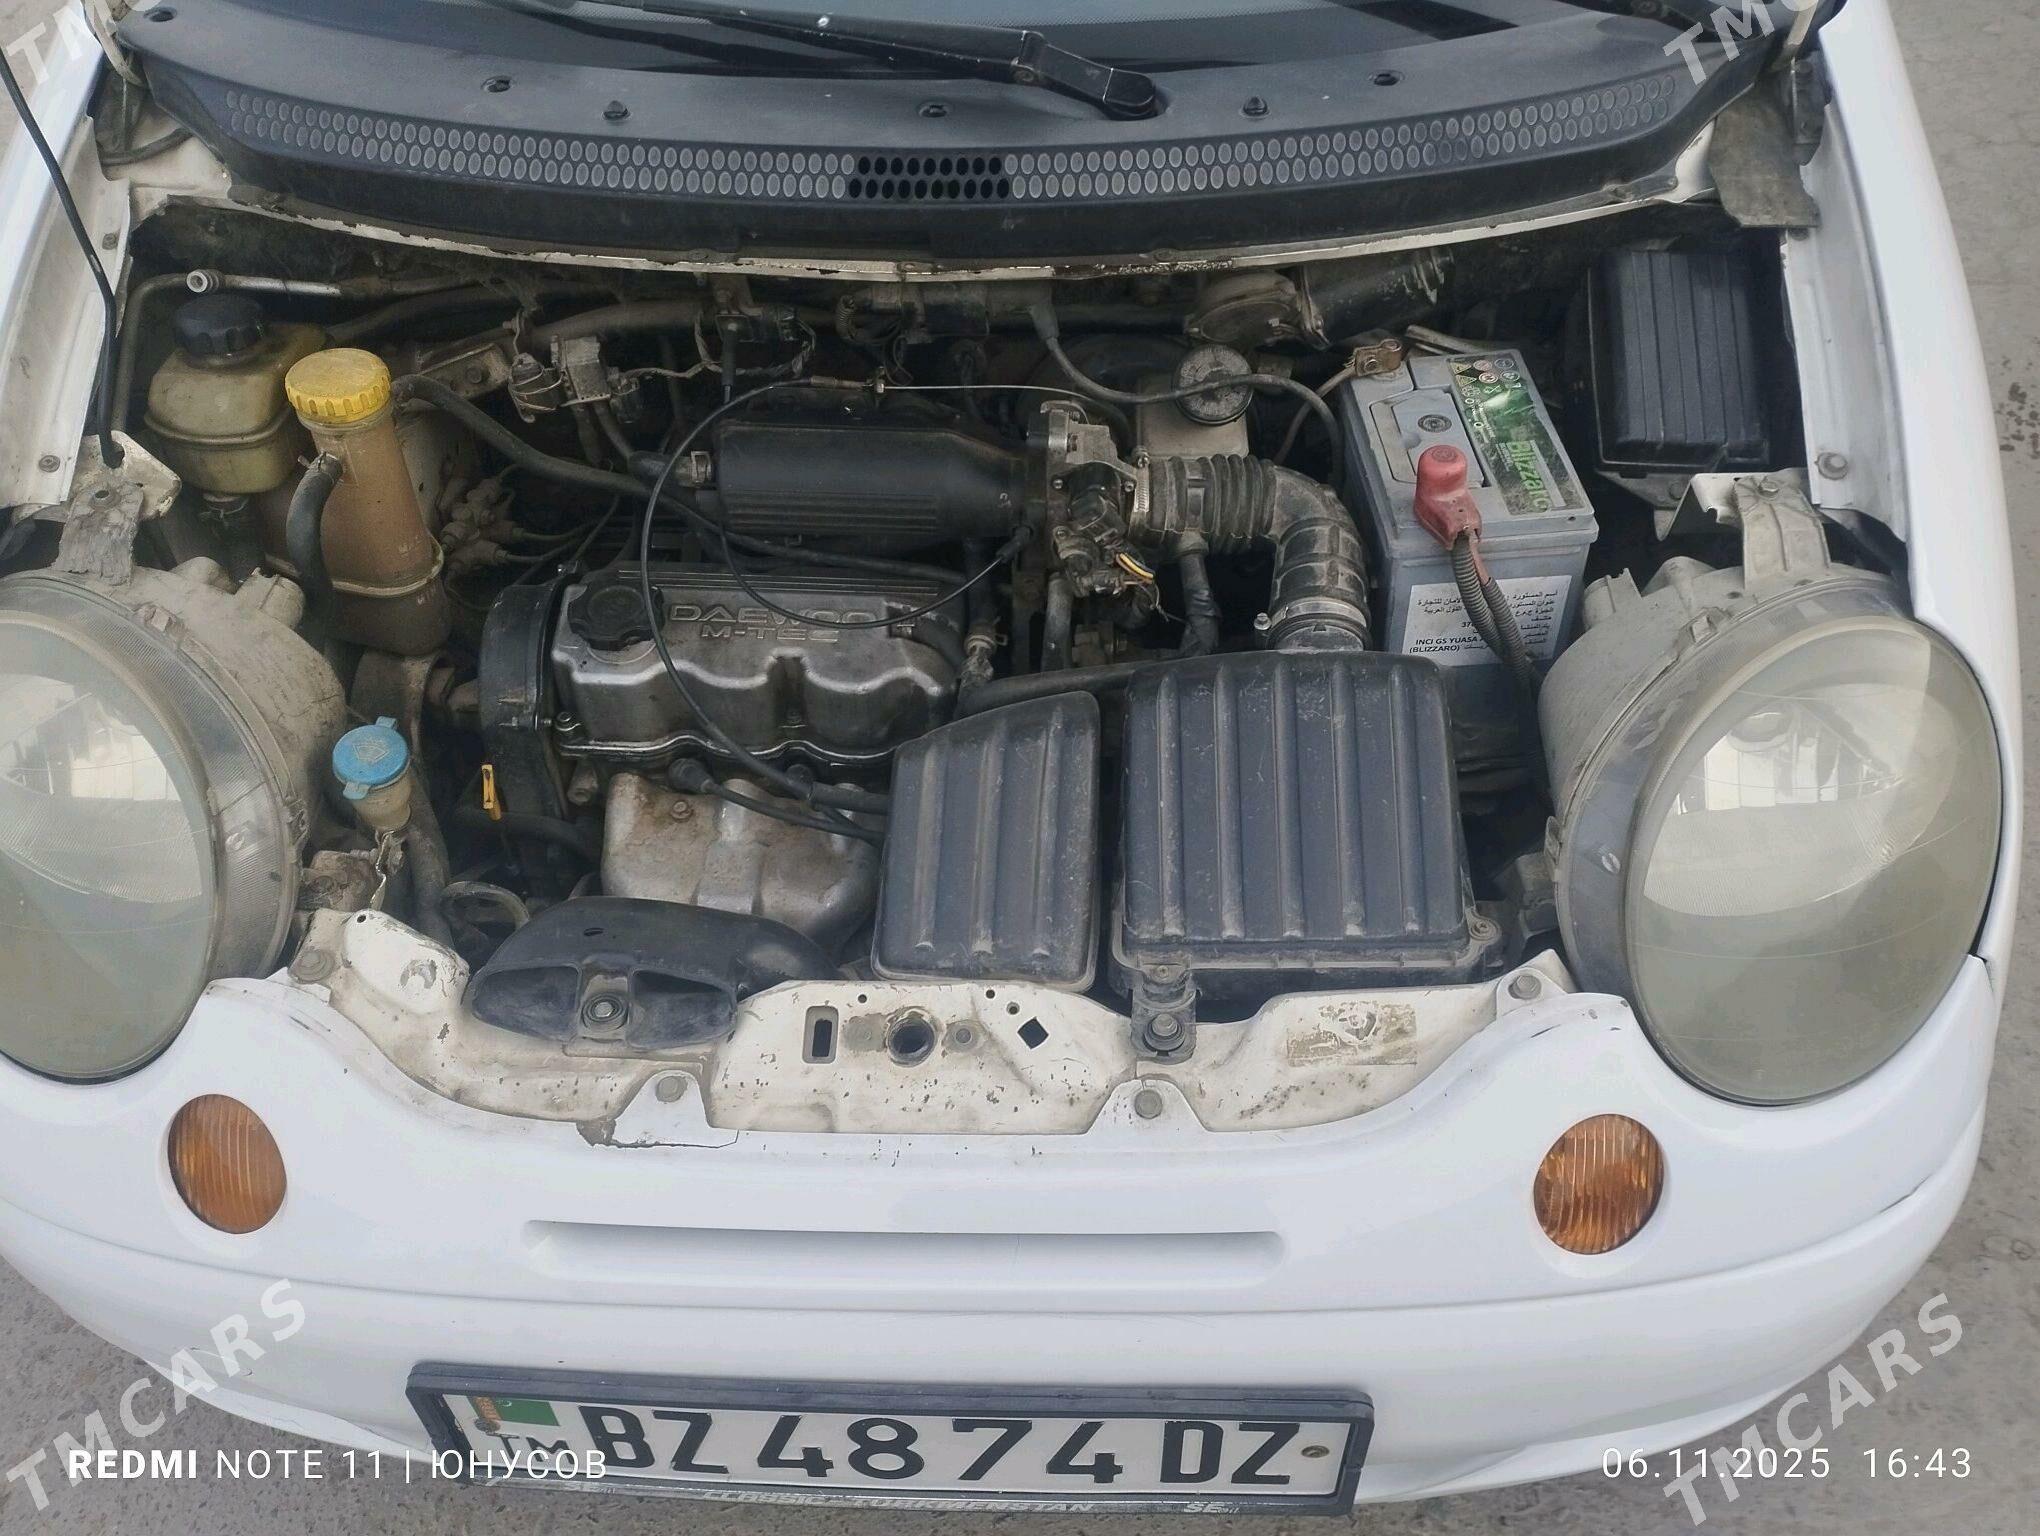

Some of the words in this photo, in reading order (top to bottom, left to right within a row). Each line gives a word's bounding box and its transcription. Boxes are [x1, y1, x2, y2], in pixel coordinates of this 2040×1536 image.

[669, 604, 878, 626] DAEWOO
[700, 624, 840, 643] M-TEC
[1449, 636, 1478, 644] YUASA
[486, 1432, 575, 1465] TM
[578, 1405, 730, 1475] BZ
[757, 1414, 1124, 1483] 4874
[1160, 1421, 1300, 1485] DZ
